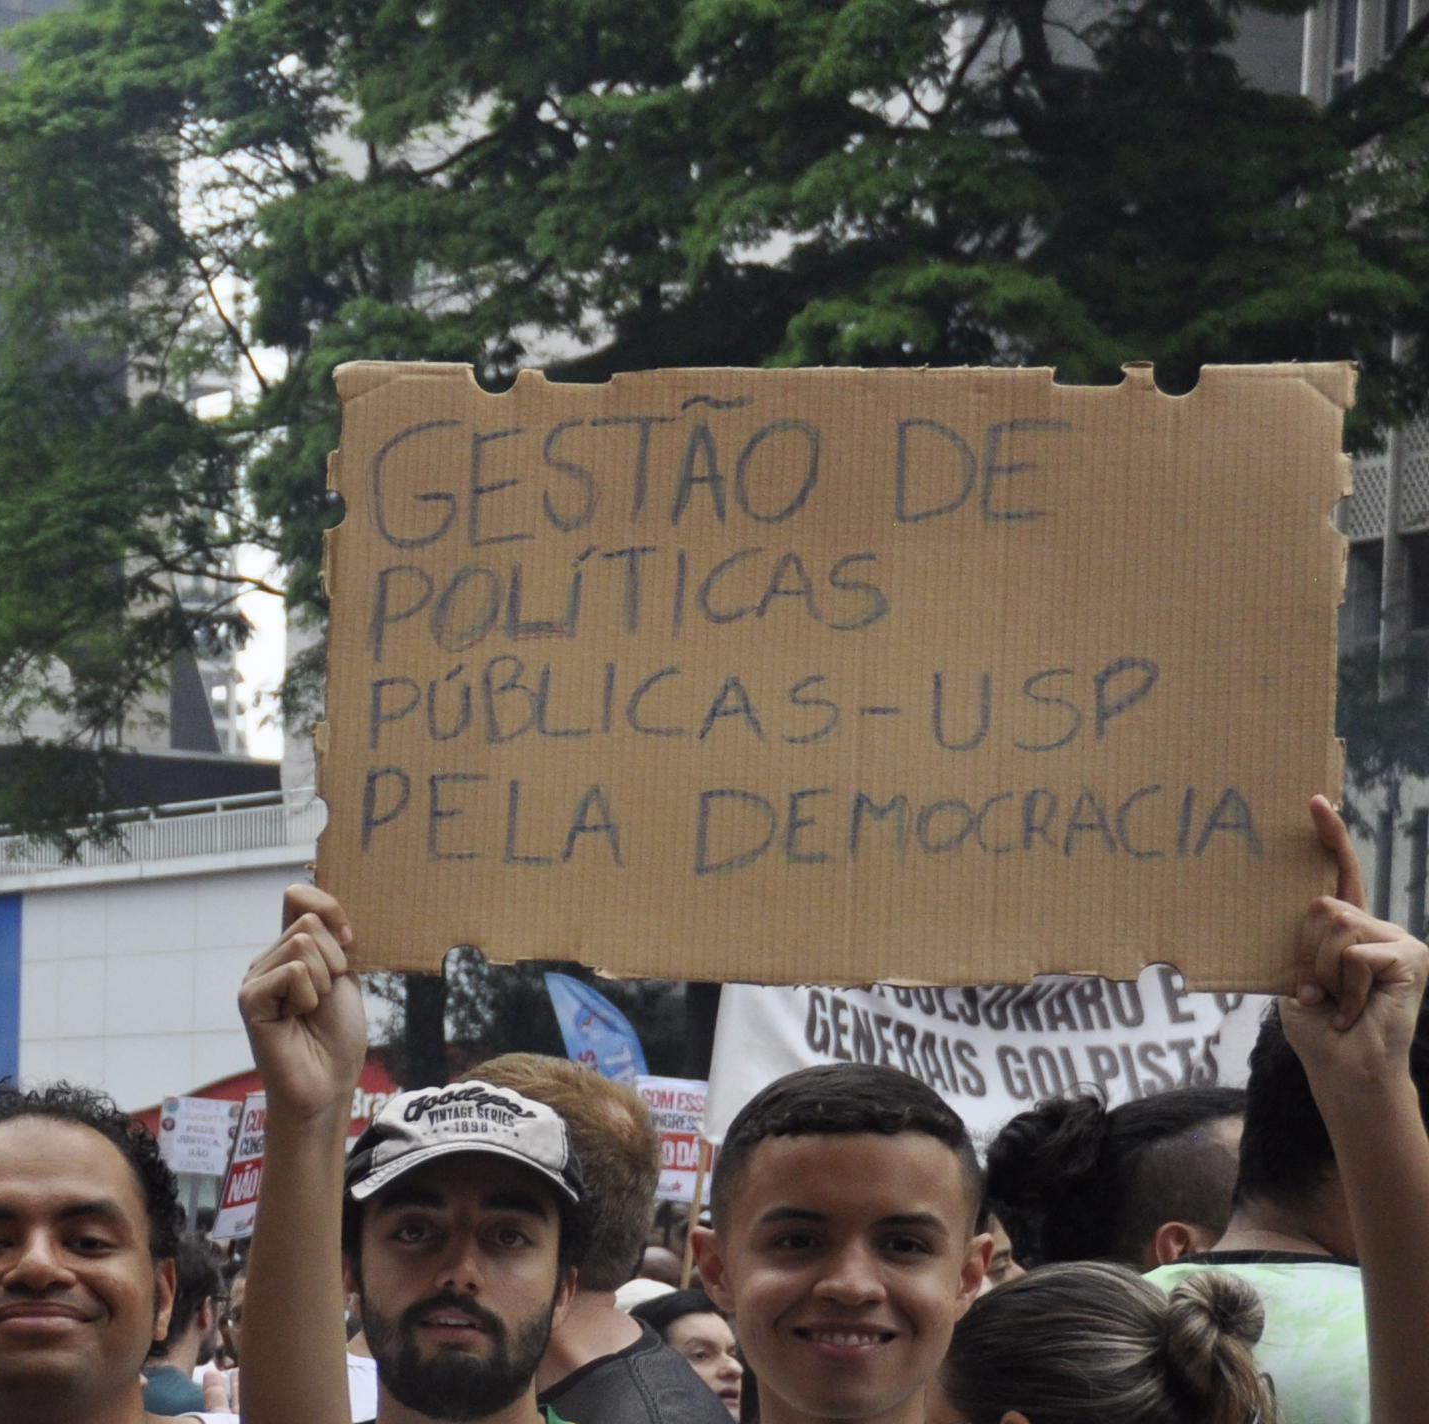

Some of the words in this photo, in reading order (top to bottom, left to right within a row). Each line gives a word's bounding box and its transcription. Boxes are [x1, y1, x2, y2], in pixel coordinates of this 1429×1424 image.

[366, 394, 822, 552] GESTÃO
[893, 416, 1077, 526] DE
[367, 545, 891, 664] POLÍTICAS
[358, 766, 627, 868] PELA
[692, 786, 1262, 877] DEMOCRACIA
[805, 988, 987, 1097] GENERAIS
[427, 1105, 474, 1127] VINTAGE
[477, 1105, 515, 1128] SERIES
